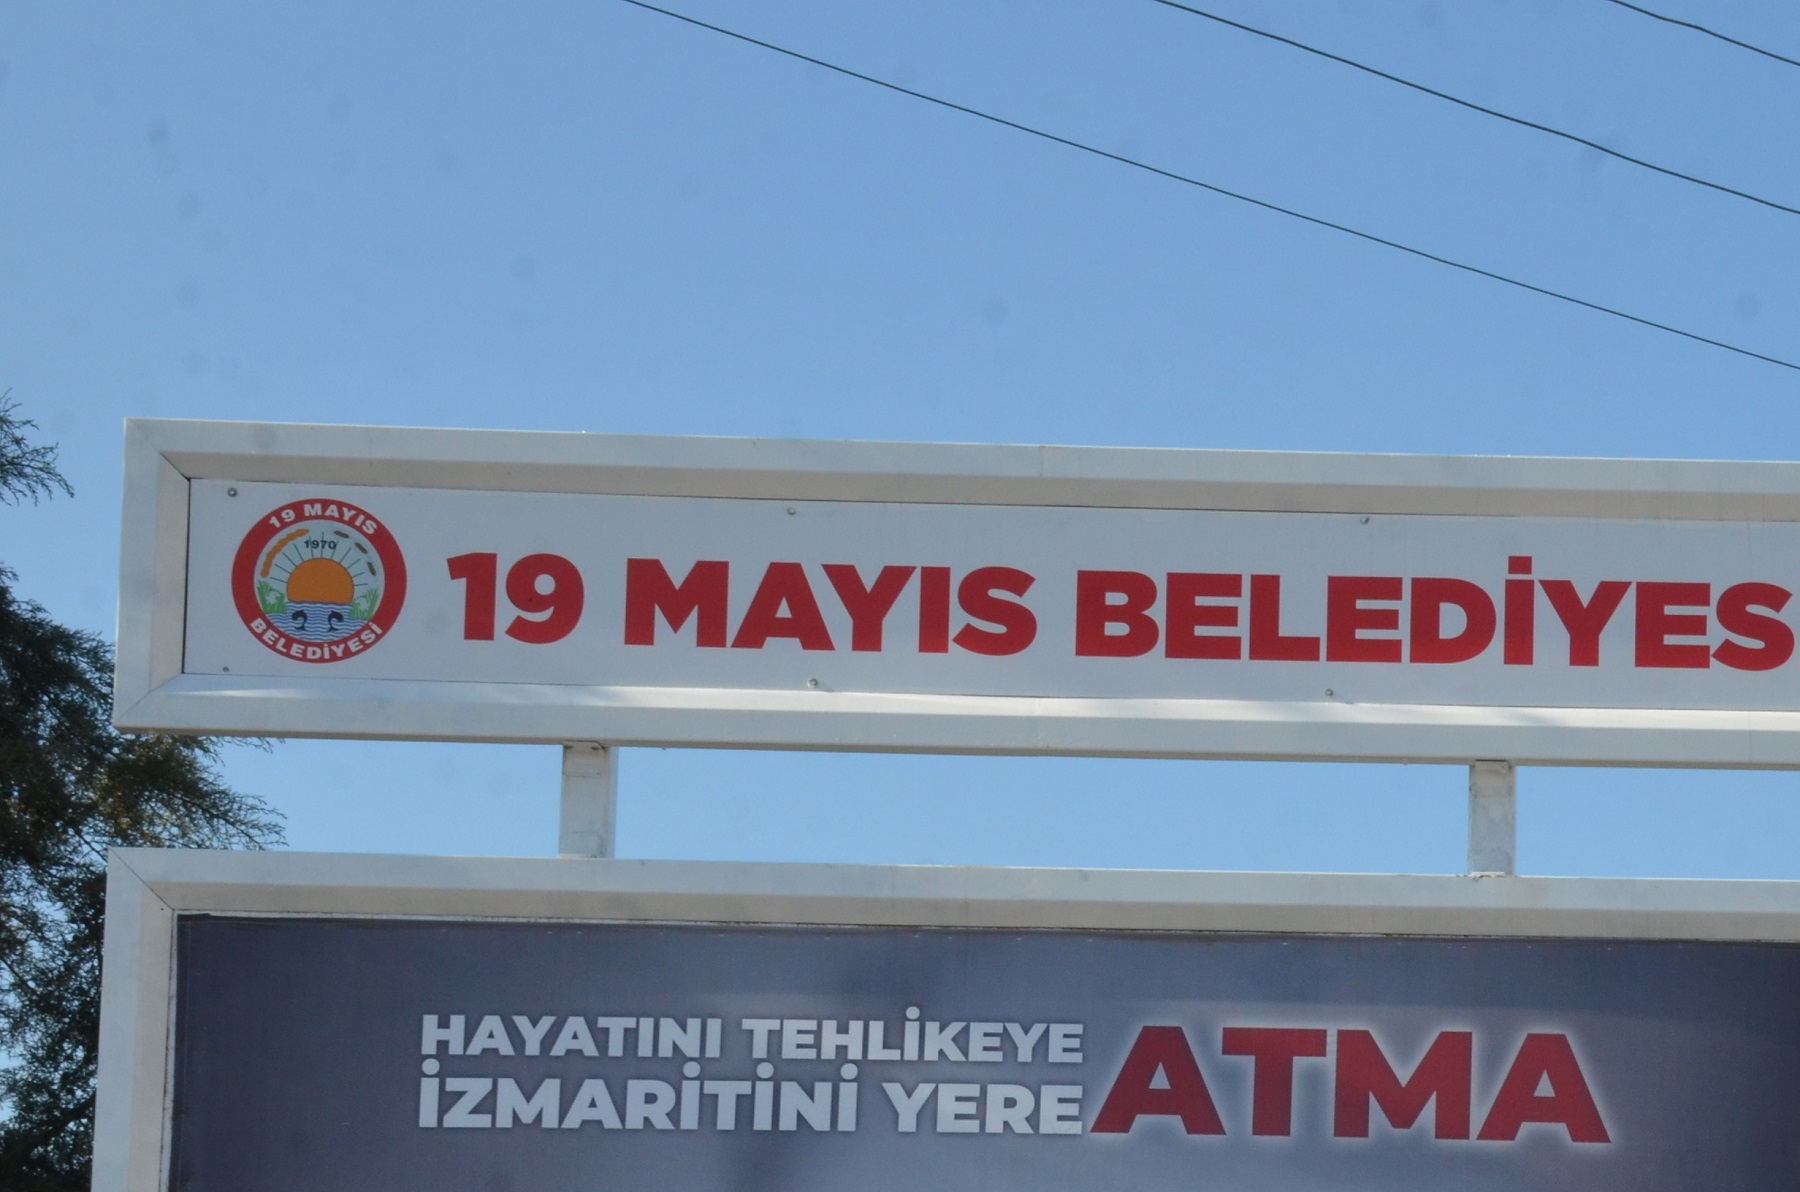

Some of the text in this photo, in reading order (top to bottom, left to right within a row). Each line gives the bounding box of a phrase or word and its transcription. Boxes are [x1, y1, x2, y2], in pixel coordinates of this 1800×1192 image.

[269, 503, 378, 535] 19 MAYIS
[304, 539, 337, 550] 1970
[446, 551, 585, 645] 19
[624, 557, 1038, 656] MAYIS
[250, 617, 383, 660] BELEDİYESİ
[420, 1006, 1084, 1064] HAYATINI TEHLİKEYE
[418, 1058, 1084, 1136] İZMARİTİNİ YERE
[1089, 1025, 1613, 1144] ATMA
